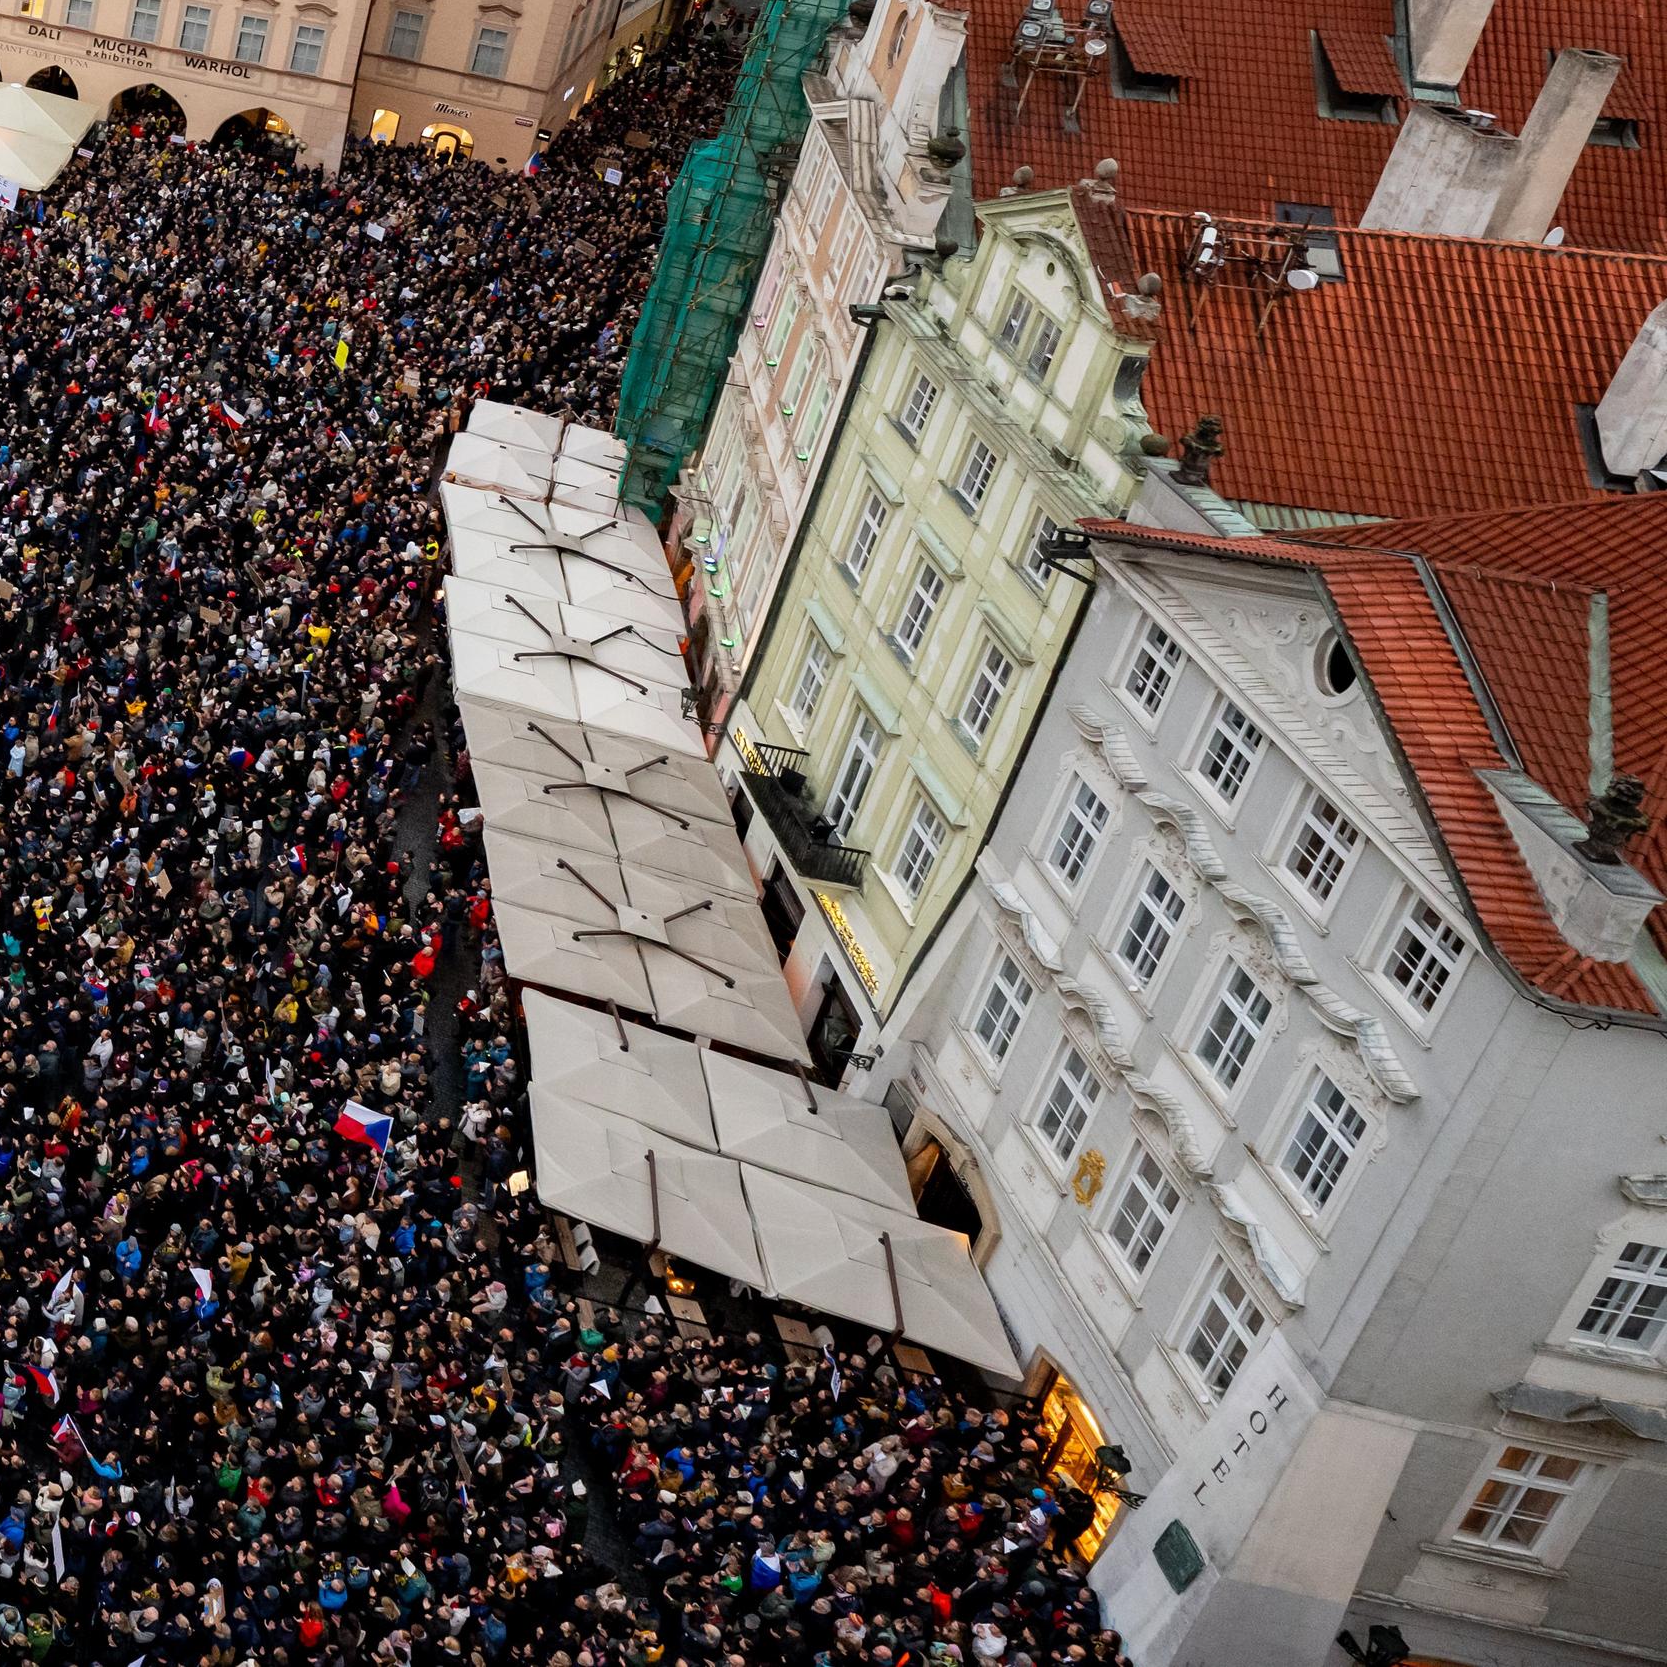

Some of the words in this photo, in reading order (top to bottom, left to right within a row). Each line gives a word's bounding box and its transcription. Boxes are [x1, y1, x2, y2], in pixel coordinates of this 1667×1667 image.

[93, 37, 148, 58] MUCHA
[86, 49, 153, 69] exhibition
[185, 56, 251, 79] WARHOL
[434, 102, 472, 119] Moser
[1194, 1384, 1289, 1506] HOTEL
